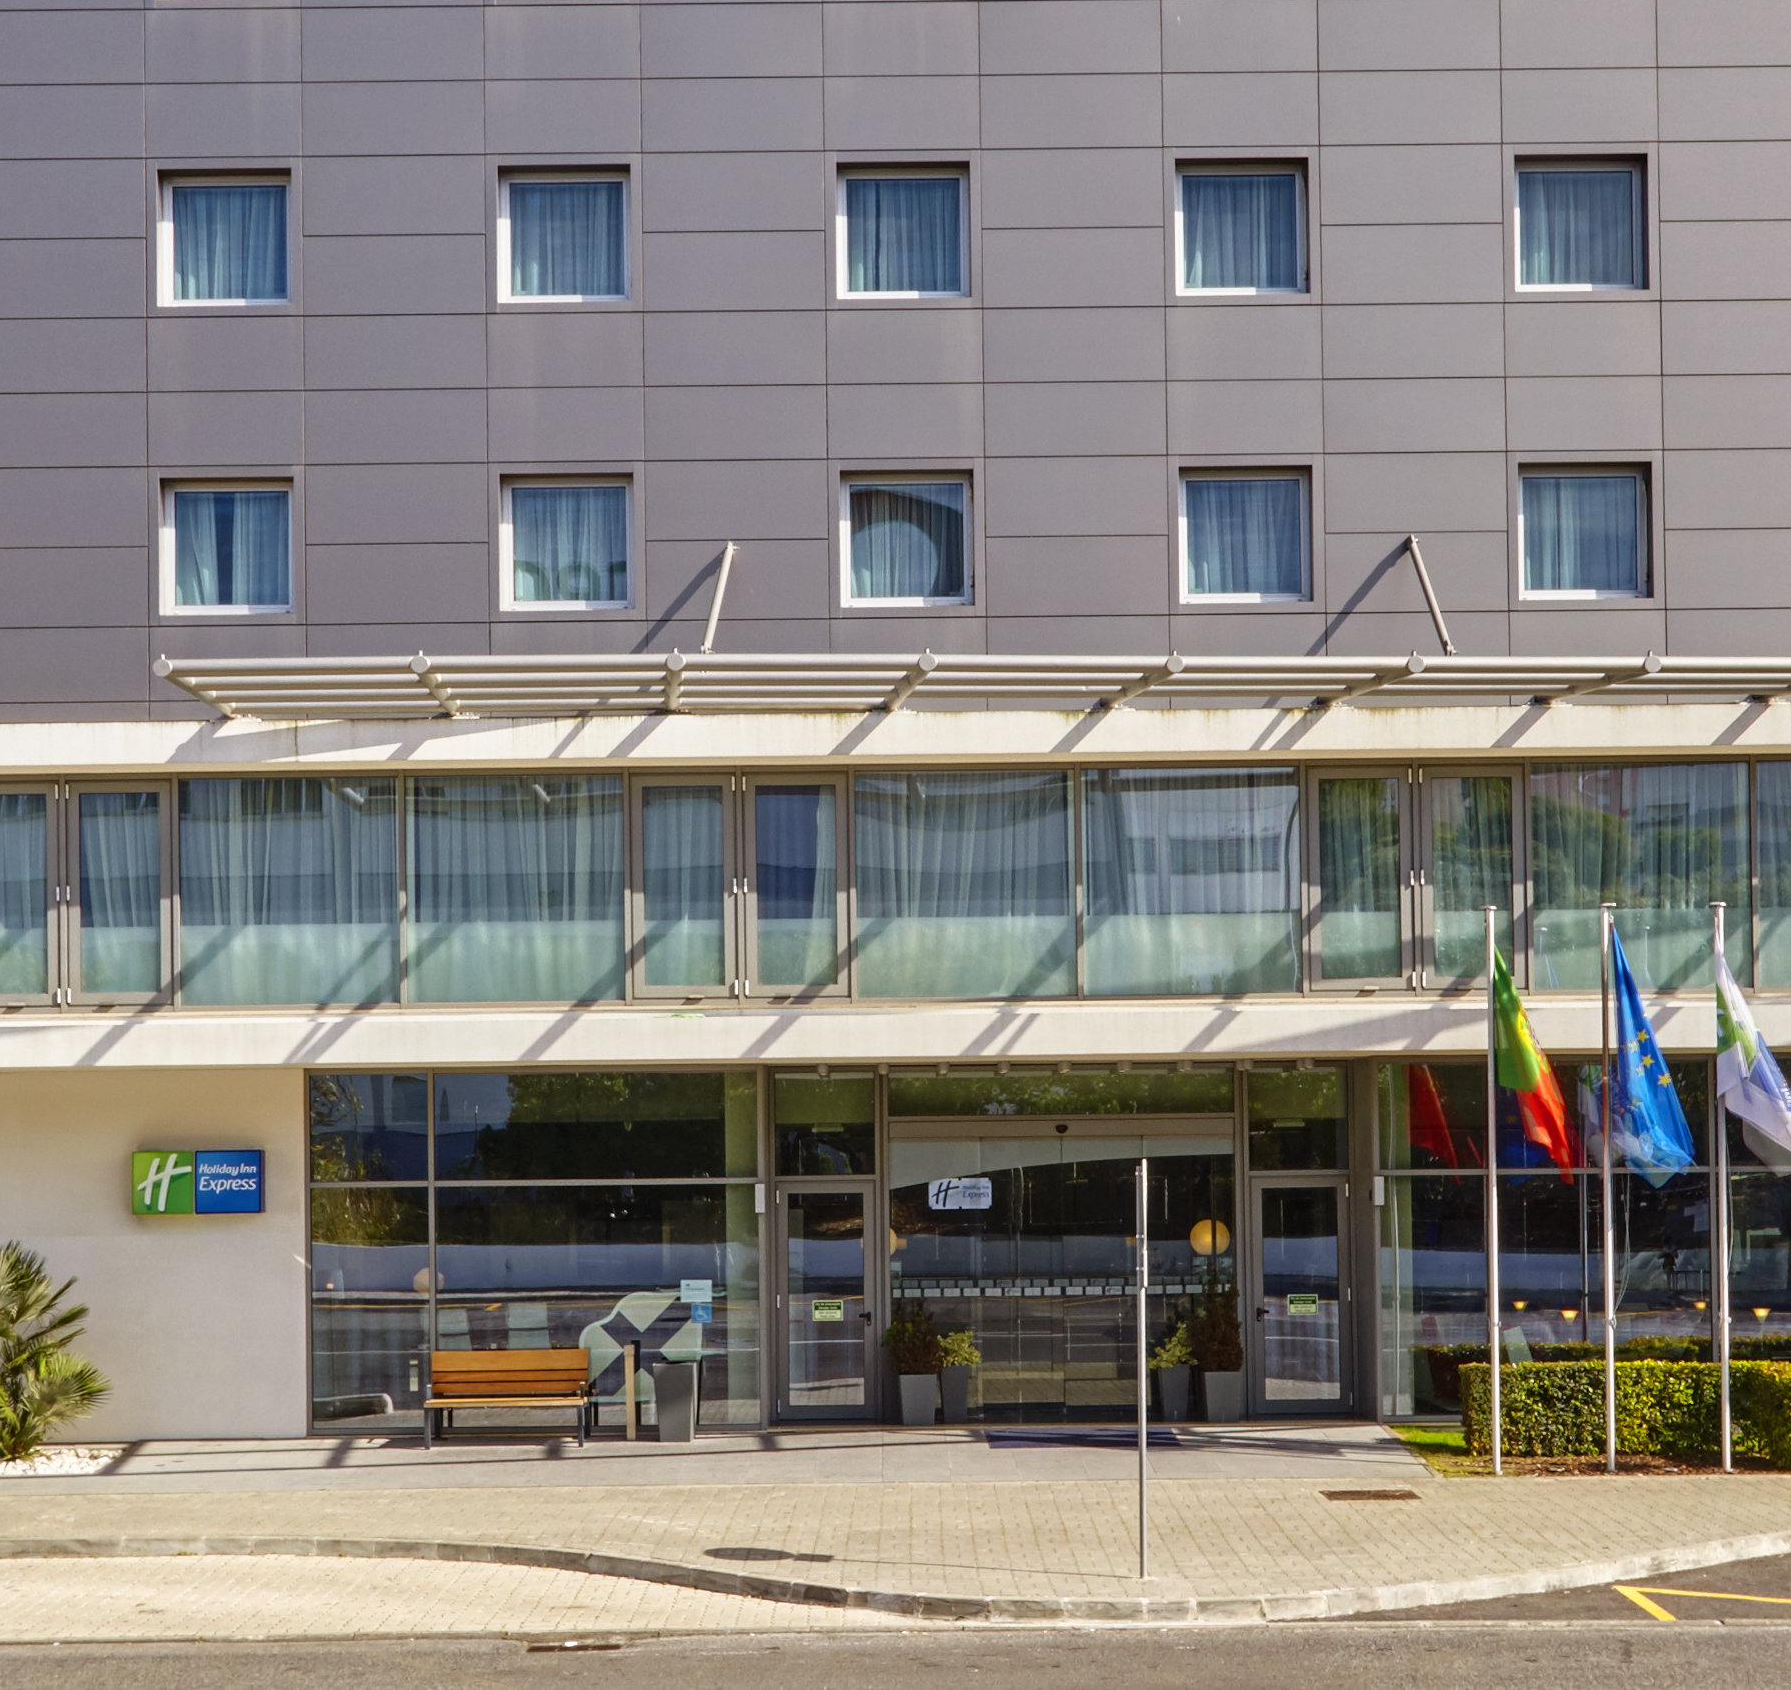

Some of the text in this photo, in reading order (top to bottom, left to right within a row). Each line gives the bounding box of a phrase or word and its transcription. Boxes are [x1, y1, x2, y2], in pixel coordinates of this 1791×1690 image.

[199, 1162, 257, 1176] Holiday Inn
[199, 1176, 258, 1194] Express
